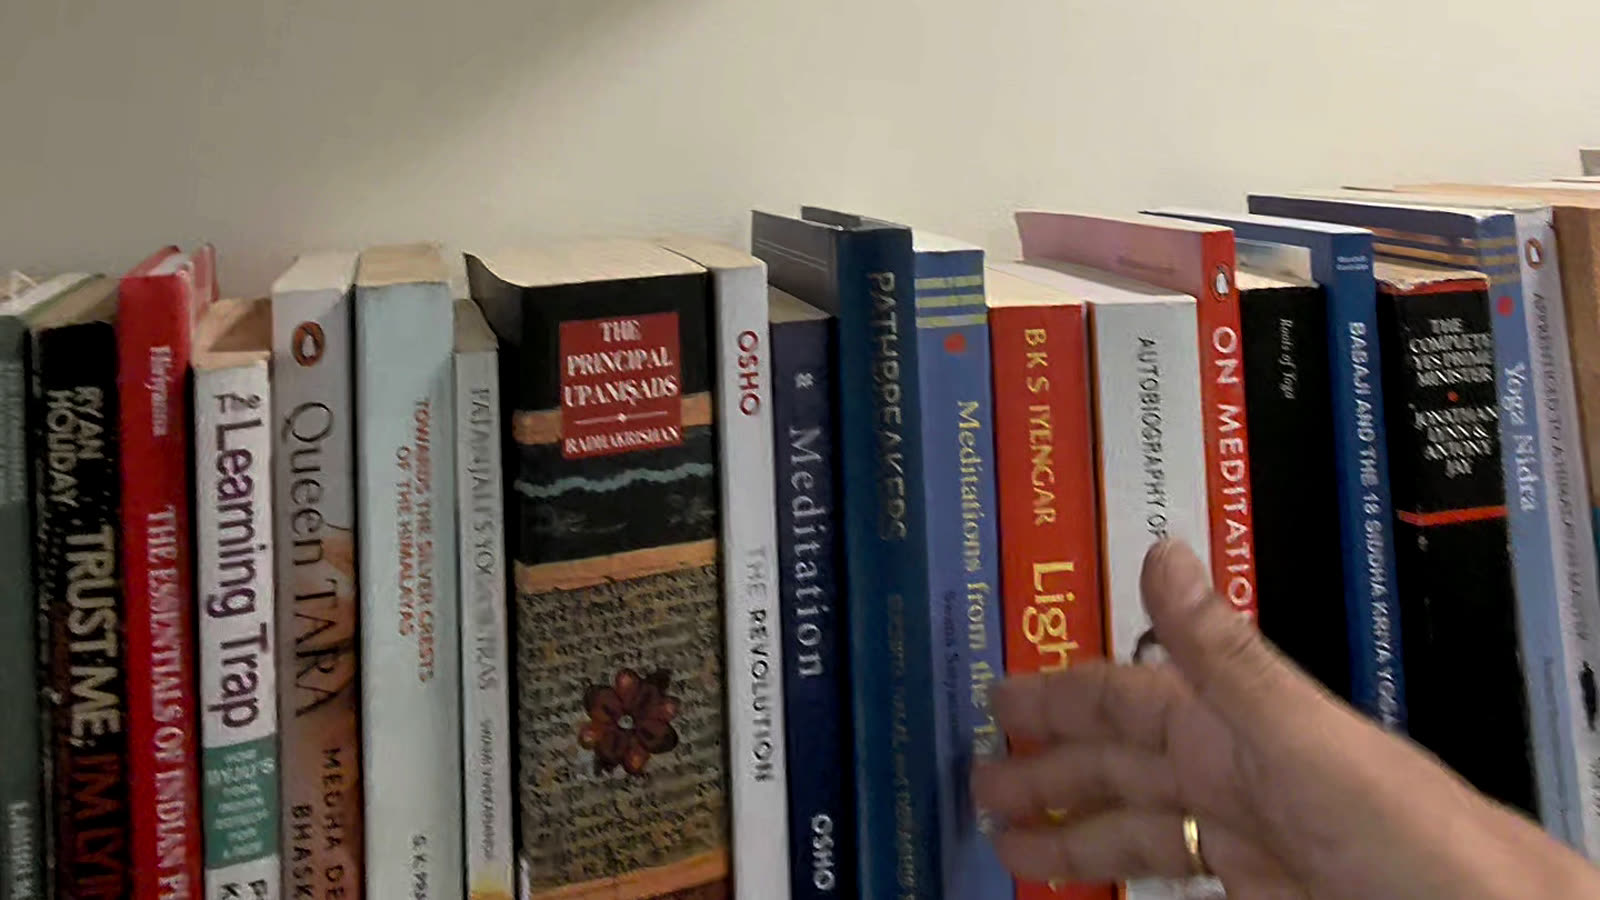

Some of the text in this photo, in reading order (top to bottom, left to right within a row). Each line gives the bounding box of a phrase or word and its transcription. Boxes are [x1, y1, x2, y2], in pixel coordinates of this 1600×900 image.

[567, 346, 675, 377] PRINCIPAL
[599, 319, 642, 343] THE
[736, 329, 762, 417] OSHO
[1278, 318, 1298, 400] Roots of Yoga
[1349, 321, 1372, 396] BABAJI
[1430, 317, 1464, 335] THE
[47, 388, 80, 508] HOLIDAY
[75, 385, 104, 460] RYAN
[1023, 327, 1057, 527] B K S IYENGAR
[1138, 336, 1168, 508] AUTOBIOGRAPHY
[1354, 399, 1376, 443] AND
[1359, 447, 1381, 487] THE
[1504, 361, 1539, 514] Yoga Nidra
[207, 417, 266, 620] Learning
[957, 400, 986, 574] Meditations
[1212, 326, 1256, 618] ON MEDITATIO
[1363, 492, 1382, 515] 18
[147, 503, 177, 564] THE
[280, 401, 345, 718] Queen TARA
[396, 445, 416, 637] OF THE HIMALAYAS
[414, 398, 434, 683] TOWARDS THE SILVER CRESTS
[788, 424, 831, 678] Meditation
[1364, 518, 1389, 597] SIDDHA
[65, 522, 119, 658] TRUST
[966, 581, 991, 650] from
[1022, 561, 1081, 674] Ligh
[1371, 600, 1393, 664] KRIYA
[148, 567, 184, 723] ESSENTIALS
[207, 621, 269, 729] Trap
[745, 545, 776, 783] THE REVOLUTION
[968, 659, 996, 710] the
[154, 726, 186, 763] OF
[155, 767, 188, 870] INDIAN
[810, 812, 837, 892] OSHO
